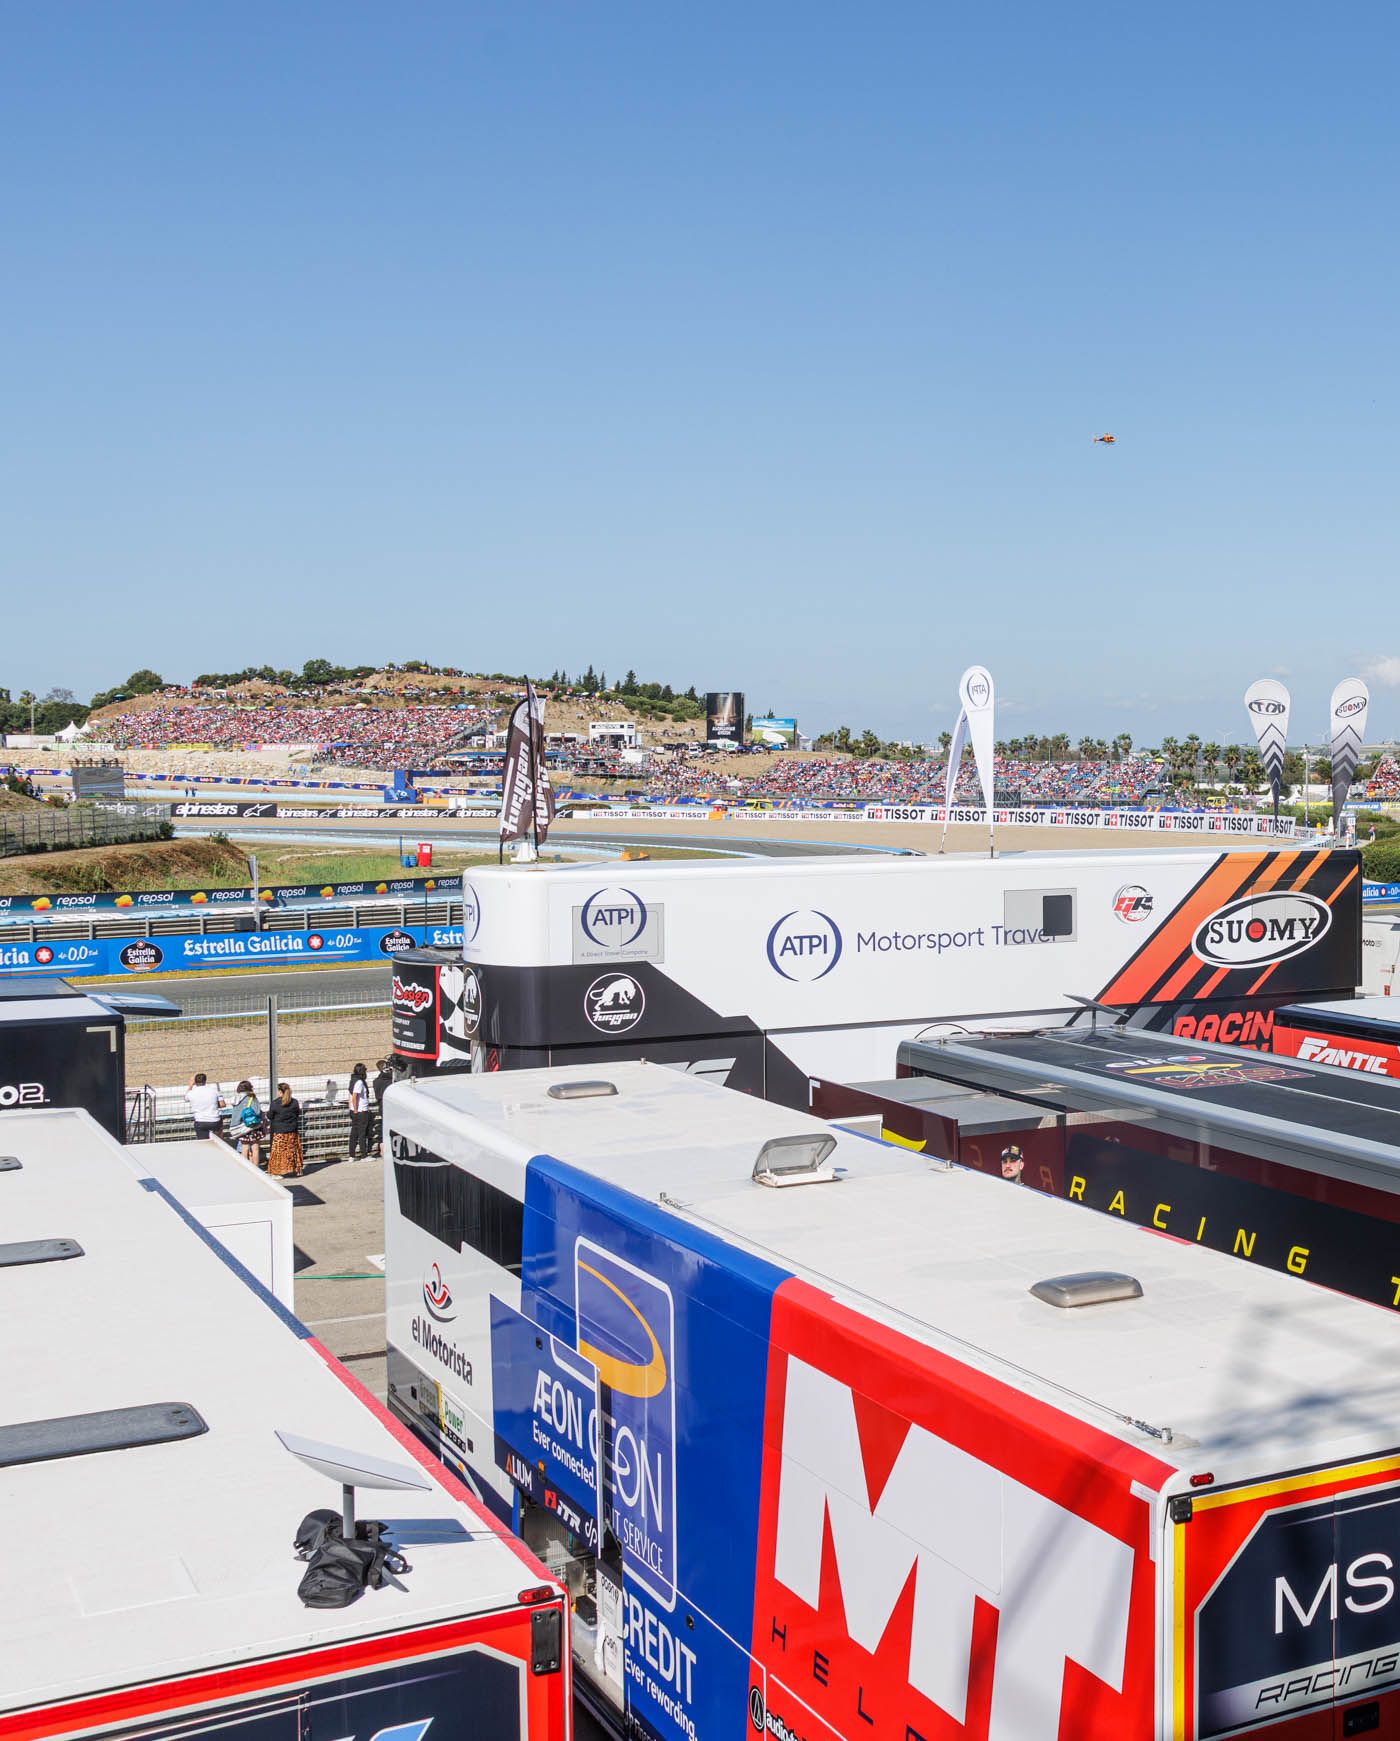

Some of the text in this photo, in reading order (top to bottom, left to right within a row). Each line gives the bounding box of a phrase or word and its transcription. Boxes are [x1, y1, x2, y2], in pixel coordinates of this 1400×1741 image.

[176, 803, 238, 817] alpinestars
[884, 808, 925, 821] TISSOT
[1009, 811, 1045, 824] TISSOT
[1066, 812, 1100, 826] TISSOT
[1119, 814, 1154, 828] TISSOT
[1173, 816, 1204, 829] TISSOT
[1223, 817, 1253, 831] TISSOT
[337, 884, 364, 894] repsol
[391, 880, 414, 890] repsol
[438, 877, 460, 887] repsol
[138, 892, 174, 904] repsol
[212, 890, 244, 901] repsol
[277, 887, 307, 899] repsol
[1362, 886, 1379, 896] alicia
[57, 895, 96, 908] repsol
[592, 908, 635, 926] ATPI
[1210, 915, 1316, 945] SUOMY
[183, 938, 246, 956] Estrella
[248, 936, 303, 953] Galicia
[780, 925, 1058, 957] ATPI Motorsport Trave
[0, 949, 29, 965] icia
[1173, 1010, 1274, 1043] RACIN
[1297, 1036, 1389, 1074] FANTIC
[1069, 1175, 1310, 1275] RACING
[412, 1317, 474, 1386] el Motorista
[445, 1396, 464, 1434] Power
[533, 1420, 550, 1452] Ever
[551, 1442, 597, 1492] connected.
[506, 1453, 533, 1492] ALIUM
[623, 1518, 664, 1577] SERVICE
[774, 1353, 1136, 1741] MT
[618, 1585, 697, 1705] CREDIT
[1255, 1652, 1400, 1709] RACING
[624, 1648, 698, 1741] Ever rewarding.
